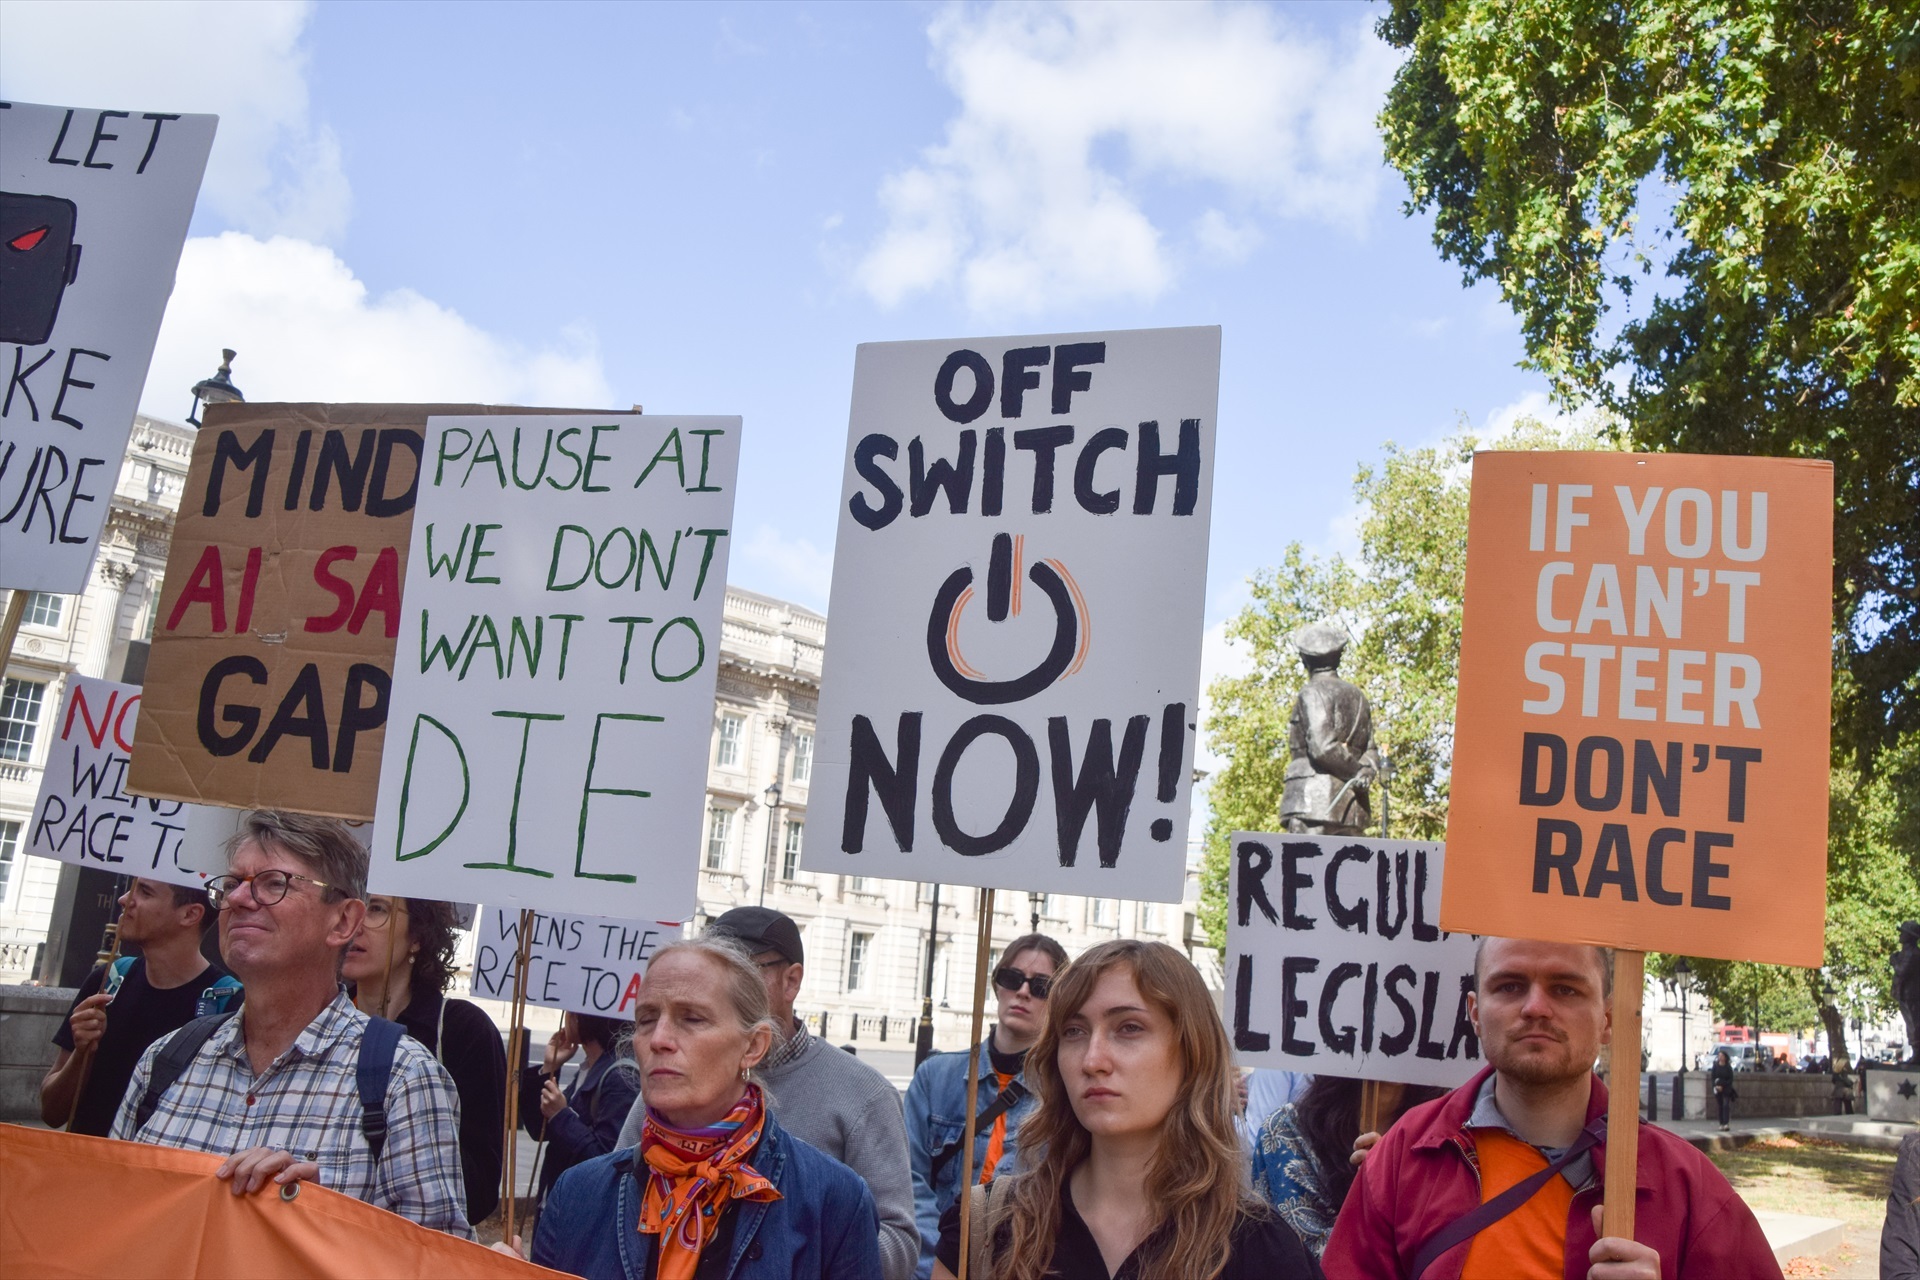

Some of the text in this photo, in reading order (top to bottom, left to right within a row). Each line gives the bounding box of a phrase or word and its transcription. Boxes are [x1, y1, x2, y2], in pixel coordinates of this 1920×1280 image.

[48, 109, 181, 174] LET
[934, 341, 1106, 424] OFF
[0, 440, 105, 544] URE
[202, 428, 422, 518] MIND
[434, 425, 725, 493] PAUSE AI
[849, 419, 1201, 531] SWITCH
[426, 523, 729, 601] WE DON'T
[1528, 483, 1768, 562] IF YOU
[165, 545, 262, 635] AI
[1536, 561, 1762, 643] CAN'T
[420, 609, 705, 684] WANT TO
[1522, 641, 1762, 729] STEER
[197, 655, 393, 773] GAP
[395, 710, 665, 884] DIE
[841, 703, 1186, 869] NOW!
[1519, 732, 1763, 823] DON'T
[33, 794, 135, 863] RACE
[1532, 818, 1734, 911] RACE
[499, 909, 659, 961] WINS THE
[1237, 840, 1480, 942] REGUL
[475, 945, 566, 1002] RACE
